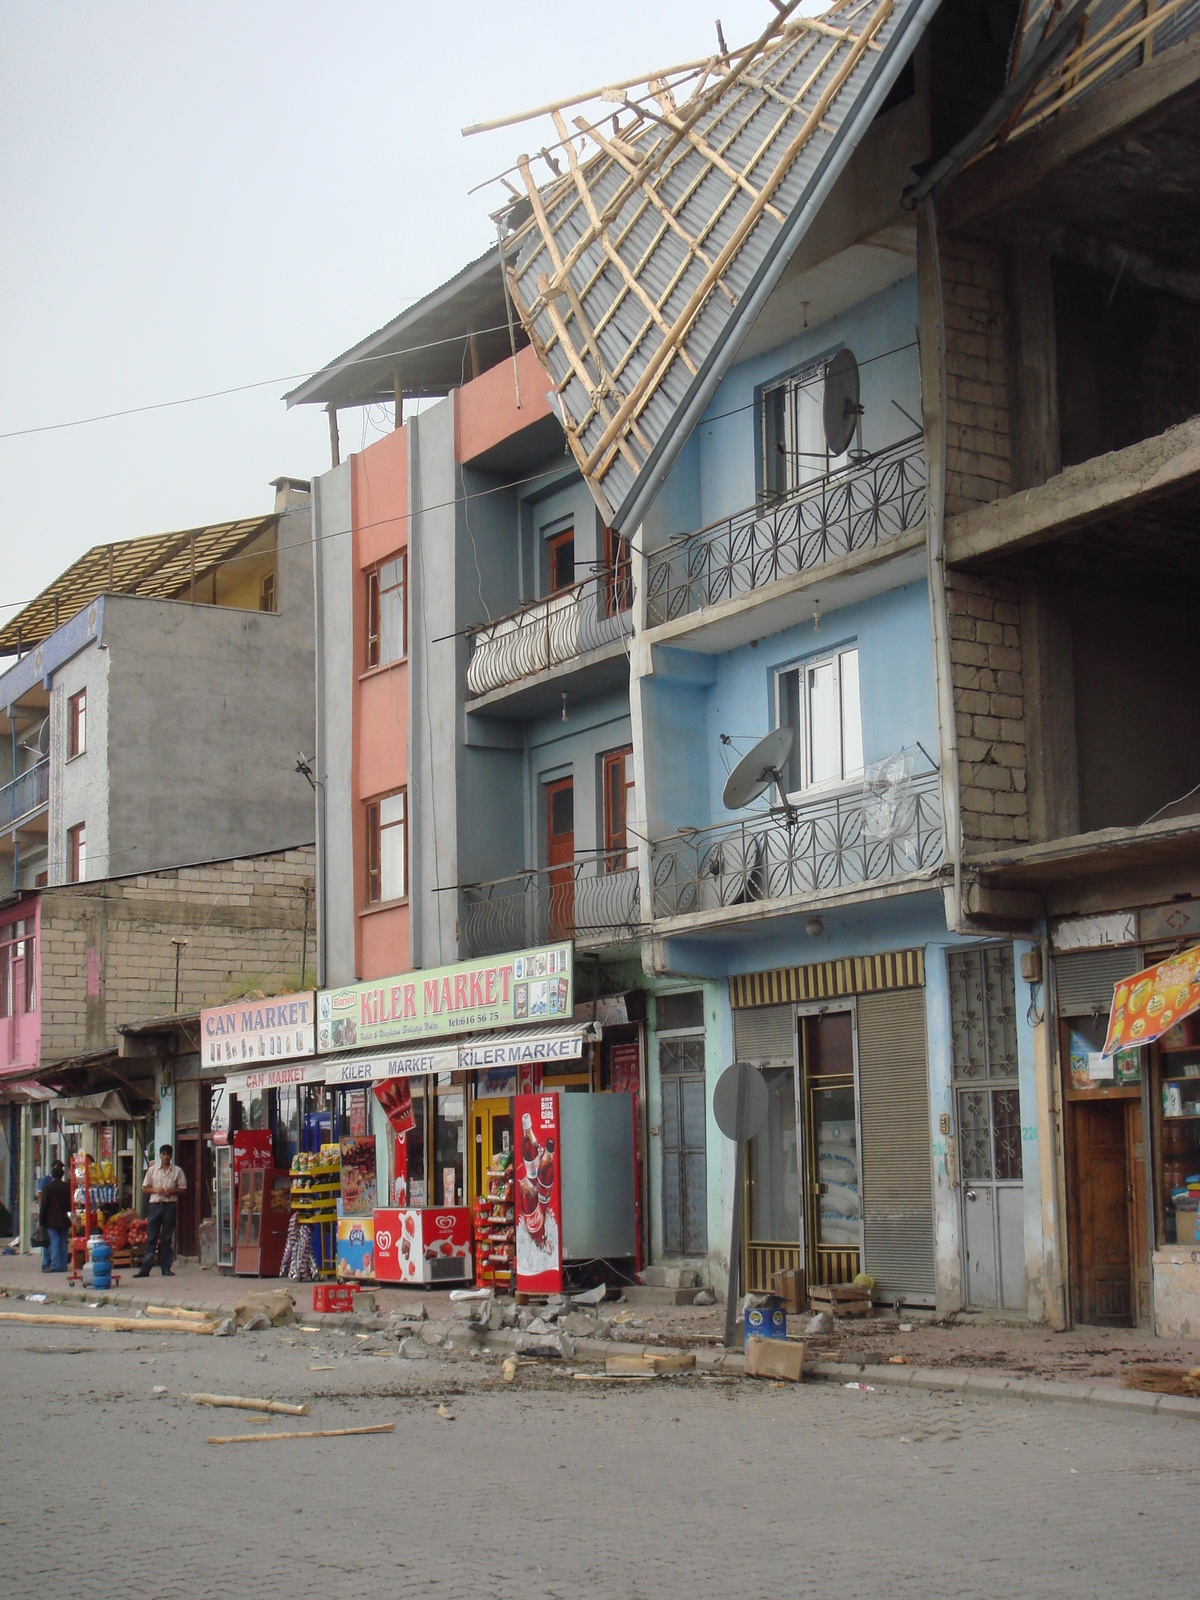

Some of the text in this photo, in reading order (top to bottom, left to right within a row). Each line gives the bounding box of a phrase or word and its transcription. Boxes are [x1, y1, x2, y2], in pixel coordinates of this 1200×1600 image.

[423, 963, 513, 1016] MARKET
[206, 1001, 309, 1037] CAN MARKET
[477, 1013, 487, 1023] 56
[489, 1011, 499, 1021] 75
[508, 1038, 581, 1062] MARKET
[388, 1056, 434, 1075] MARKET
[246, 1067, 306, 1088] CAN MARKET
